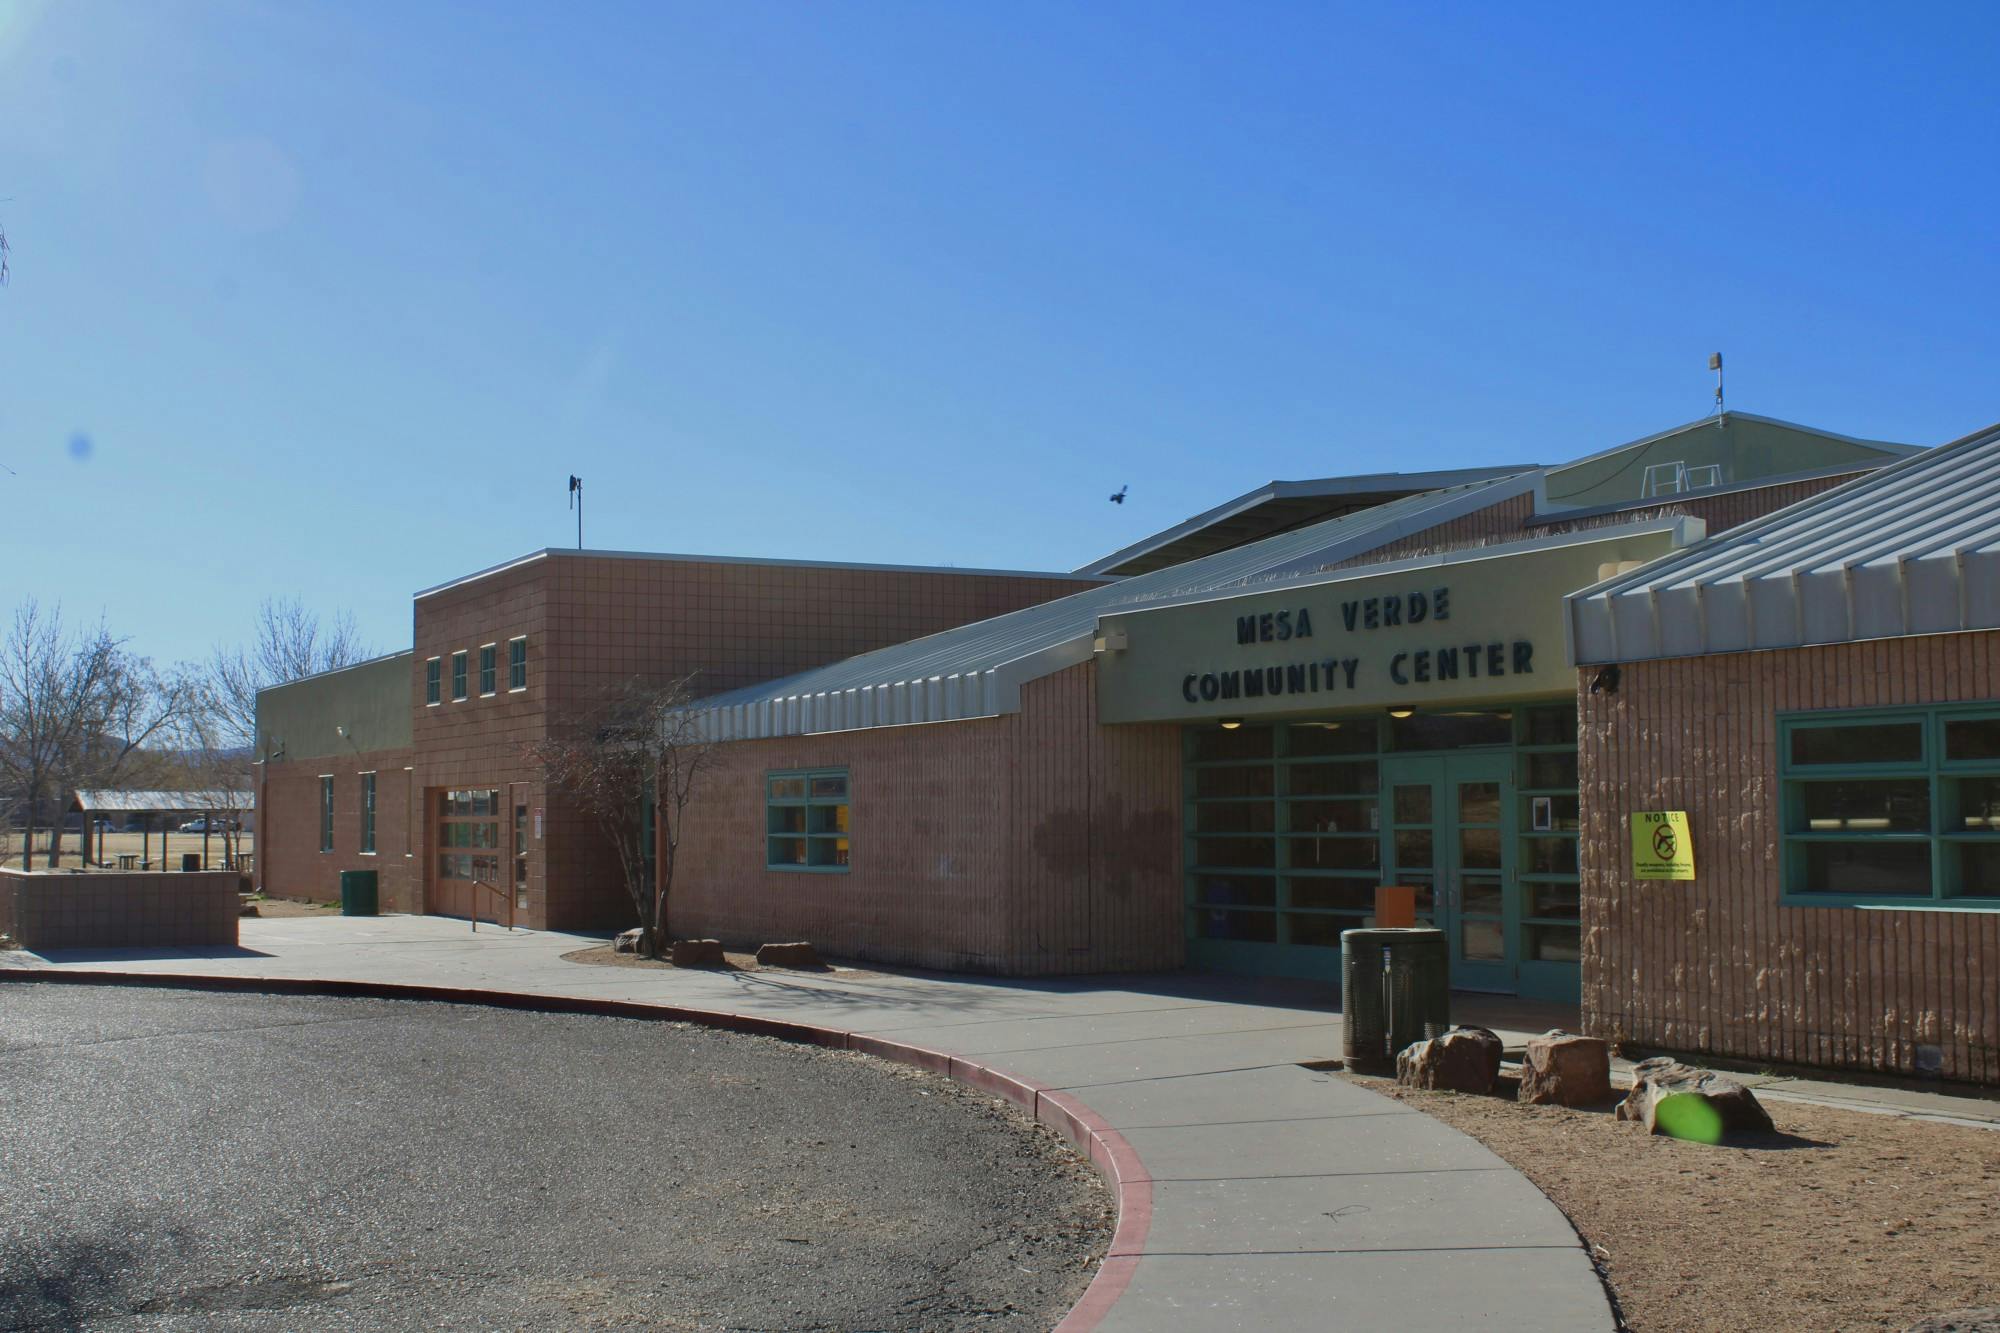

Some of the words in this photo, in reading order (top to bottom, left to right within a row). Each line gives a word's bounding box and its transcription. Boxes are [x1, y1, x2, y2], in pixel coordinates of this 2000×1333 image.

[1237, 609, 1312, 644] MESA
[1341, 587, 1449, 632] VERDE
[1182, 658, 1359, 703] COMMUNITY
[1390, 640, 1534, 685] CENTER
